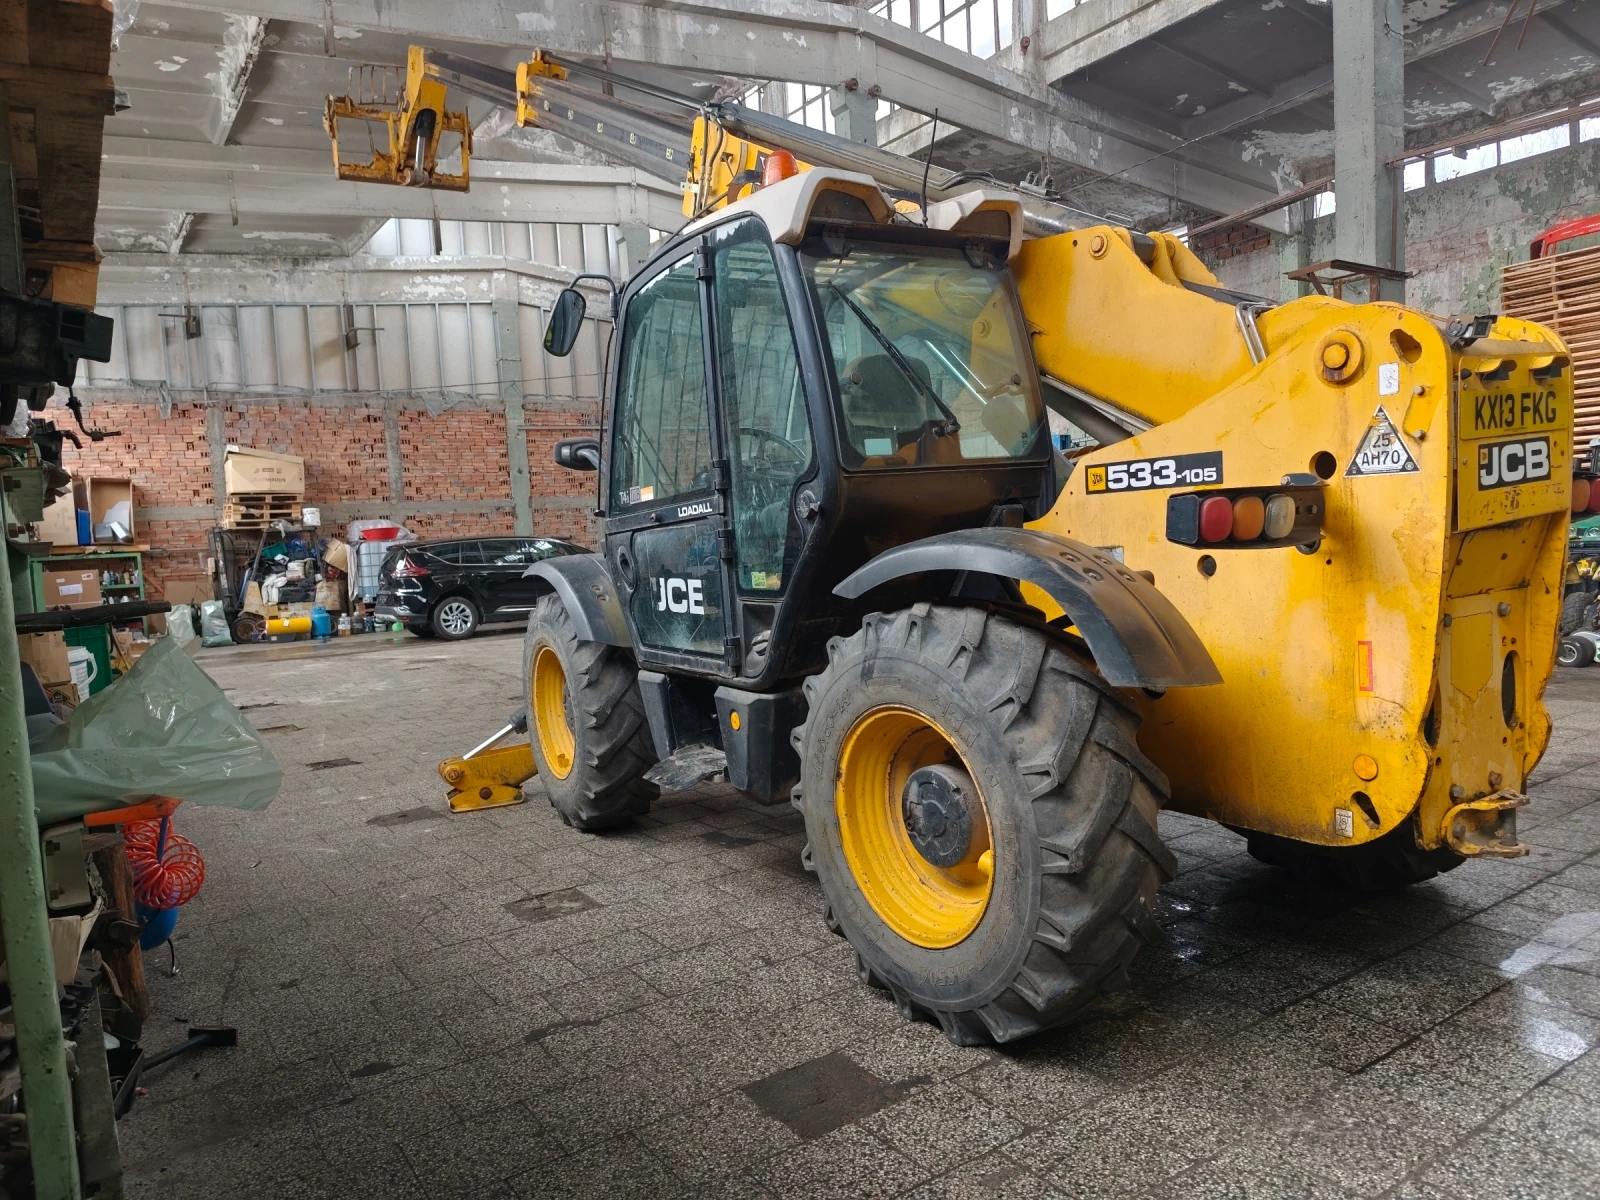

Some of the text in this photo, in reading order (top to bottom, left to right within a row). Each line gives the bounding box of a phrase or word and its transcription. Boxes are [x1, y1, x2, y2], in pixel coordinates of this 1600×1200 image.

[1475, 390, 1556, 430] KX13 FKG
[1361, 450, 1400, 466] AH70
[1480, 440, 1549, 486] JCB
[1107, 459, 1217, 490] 533-105
[677, 502, 713, 518] LOADALL
